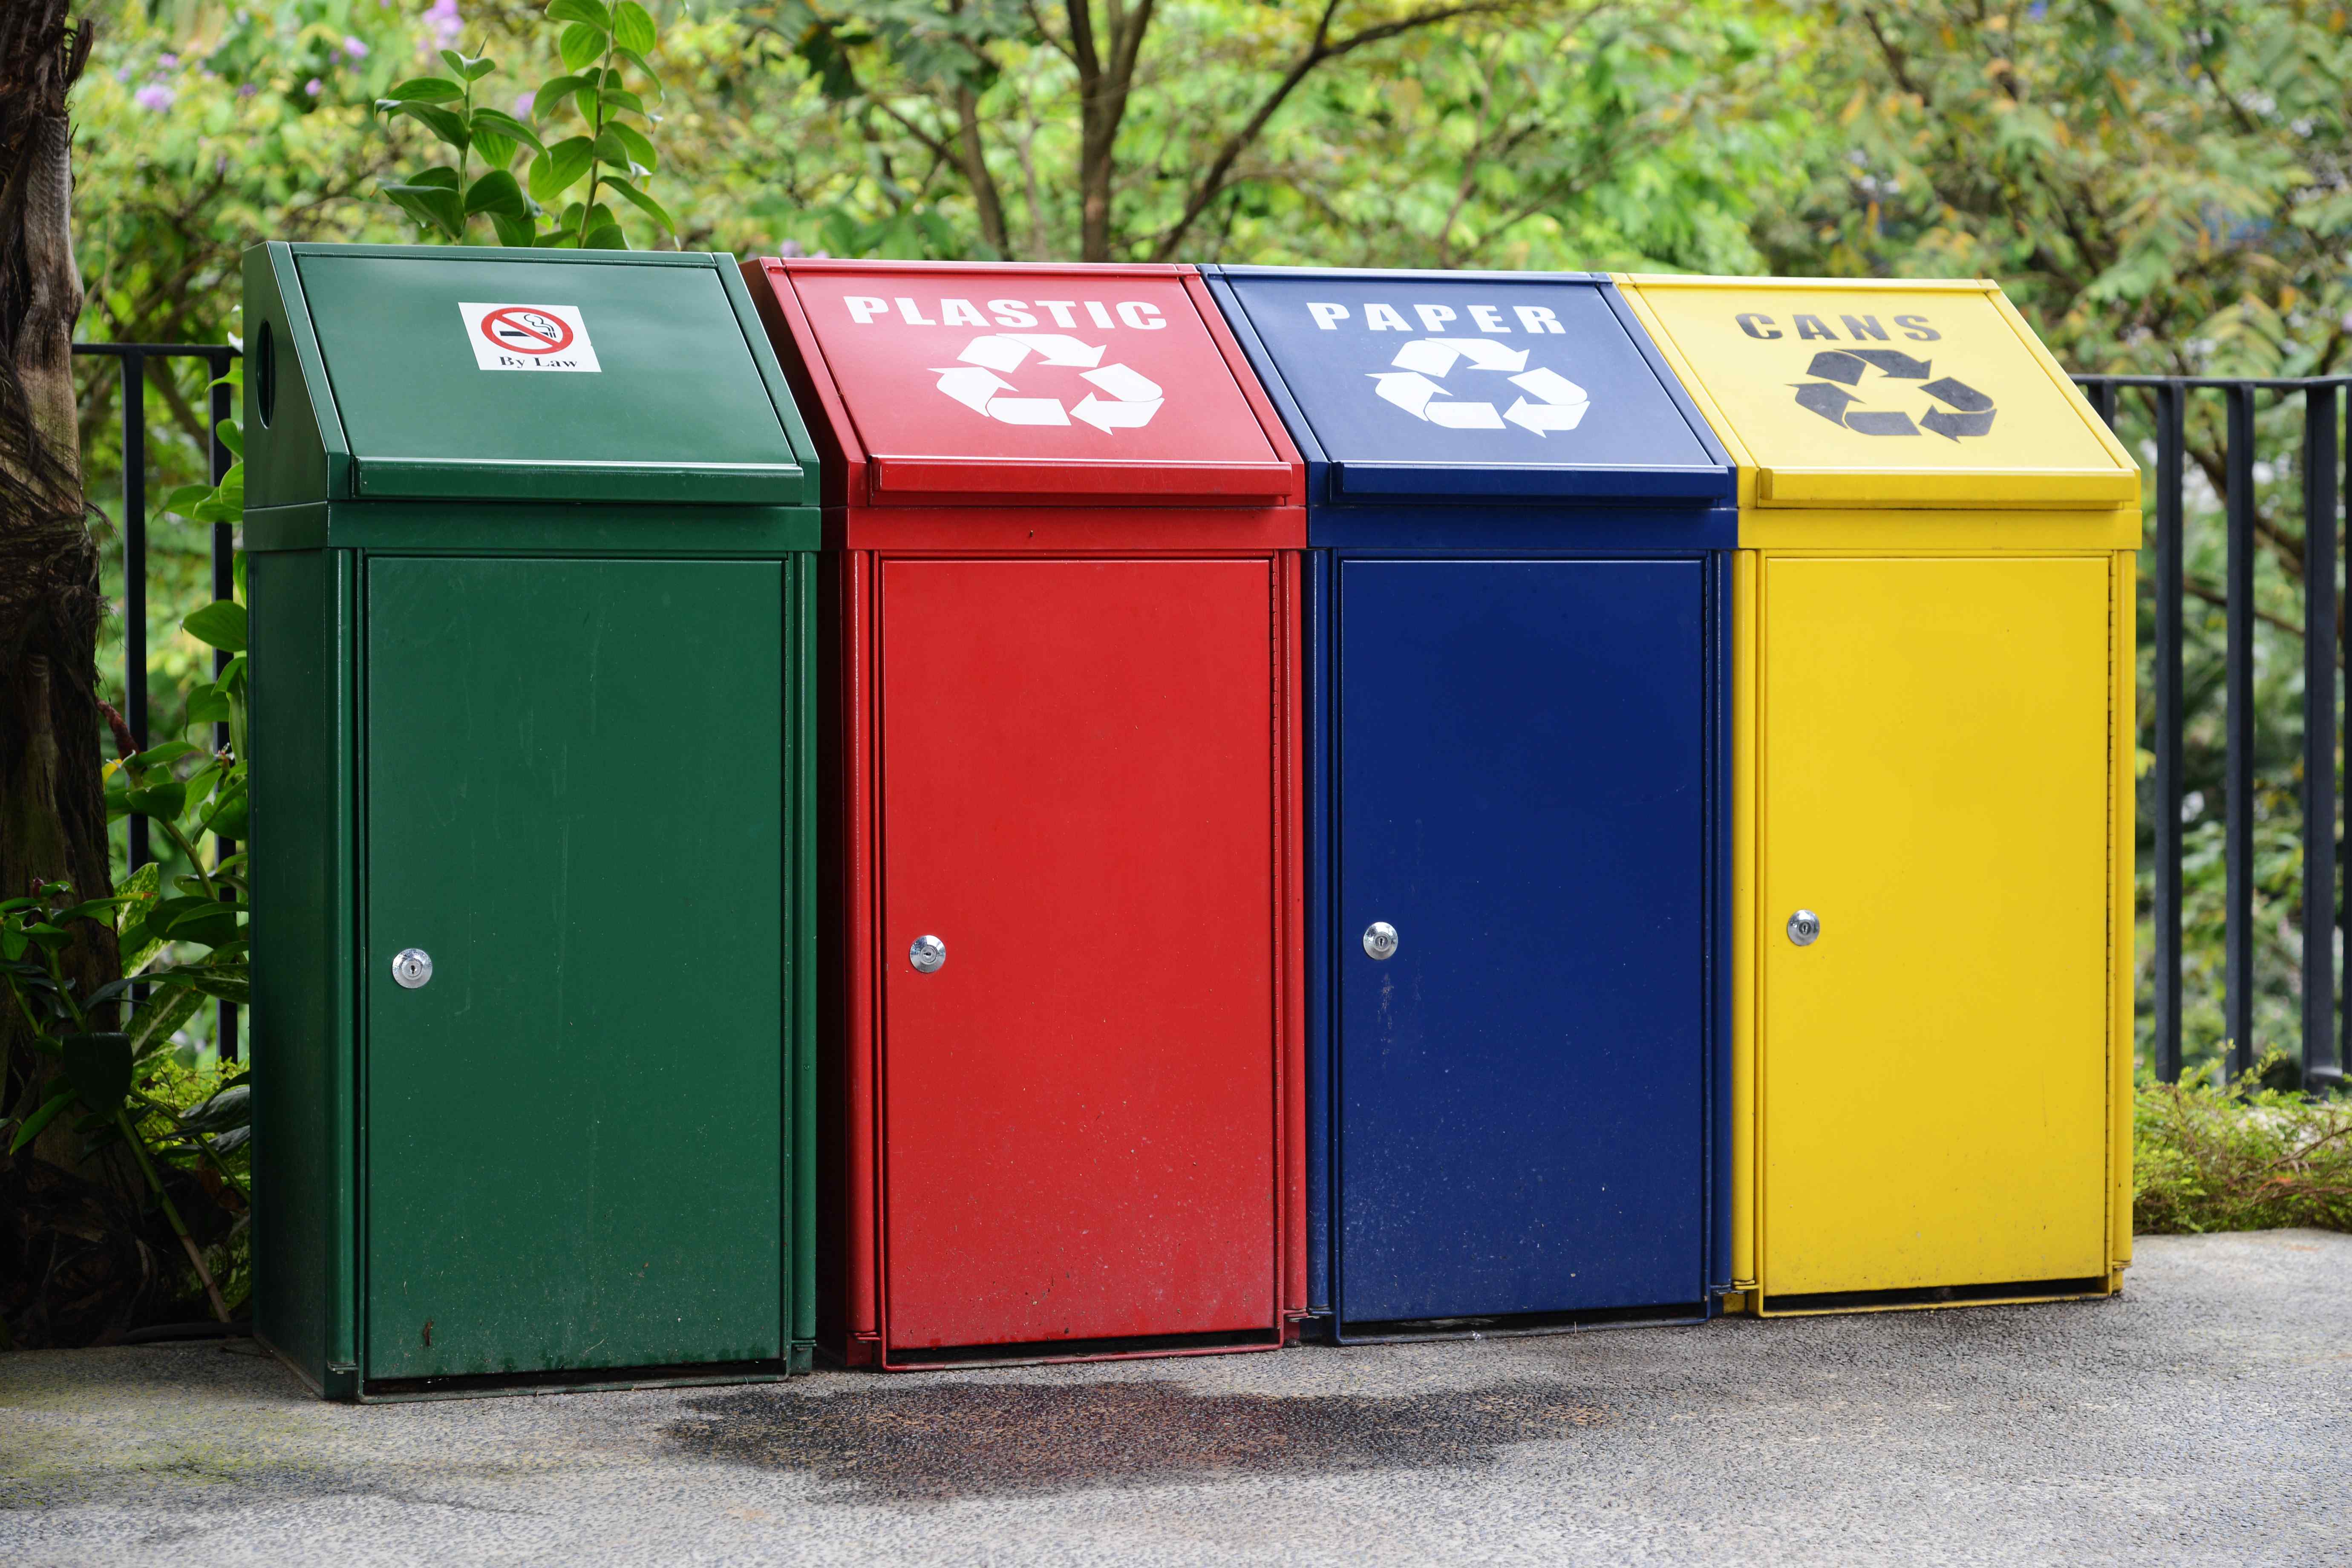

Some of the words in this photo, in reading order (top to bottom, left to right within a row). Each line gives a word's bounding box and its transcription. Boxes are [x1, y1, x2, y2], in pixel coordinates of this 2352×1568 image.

[843, 296, 1167, 329] PLASTIC
[1306, 302, 1566, 334] PAPER
[1735, 313, 1942, 341] CANS
[499, 356, 525, 368] By
[534, 357, 577, 367] Law
